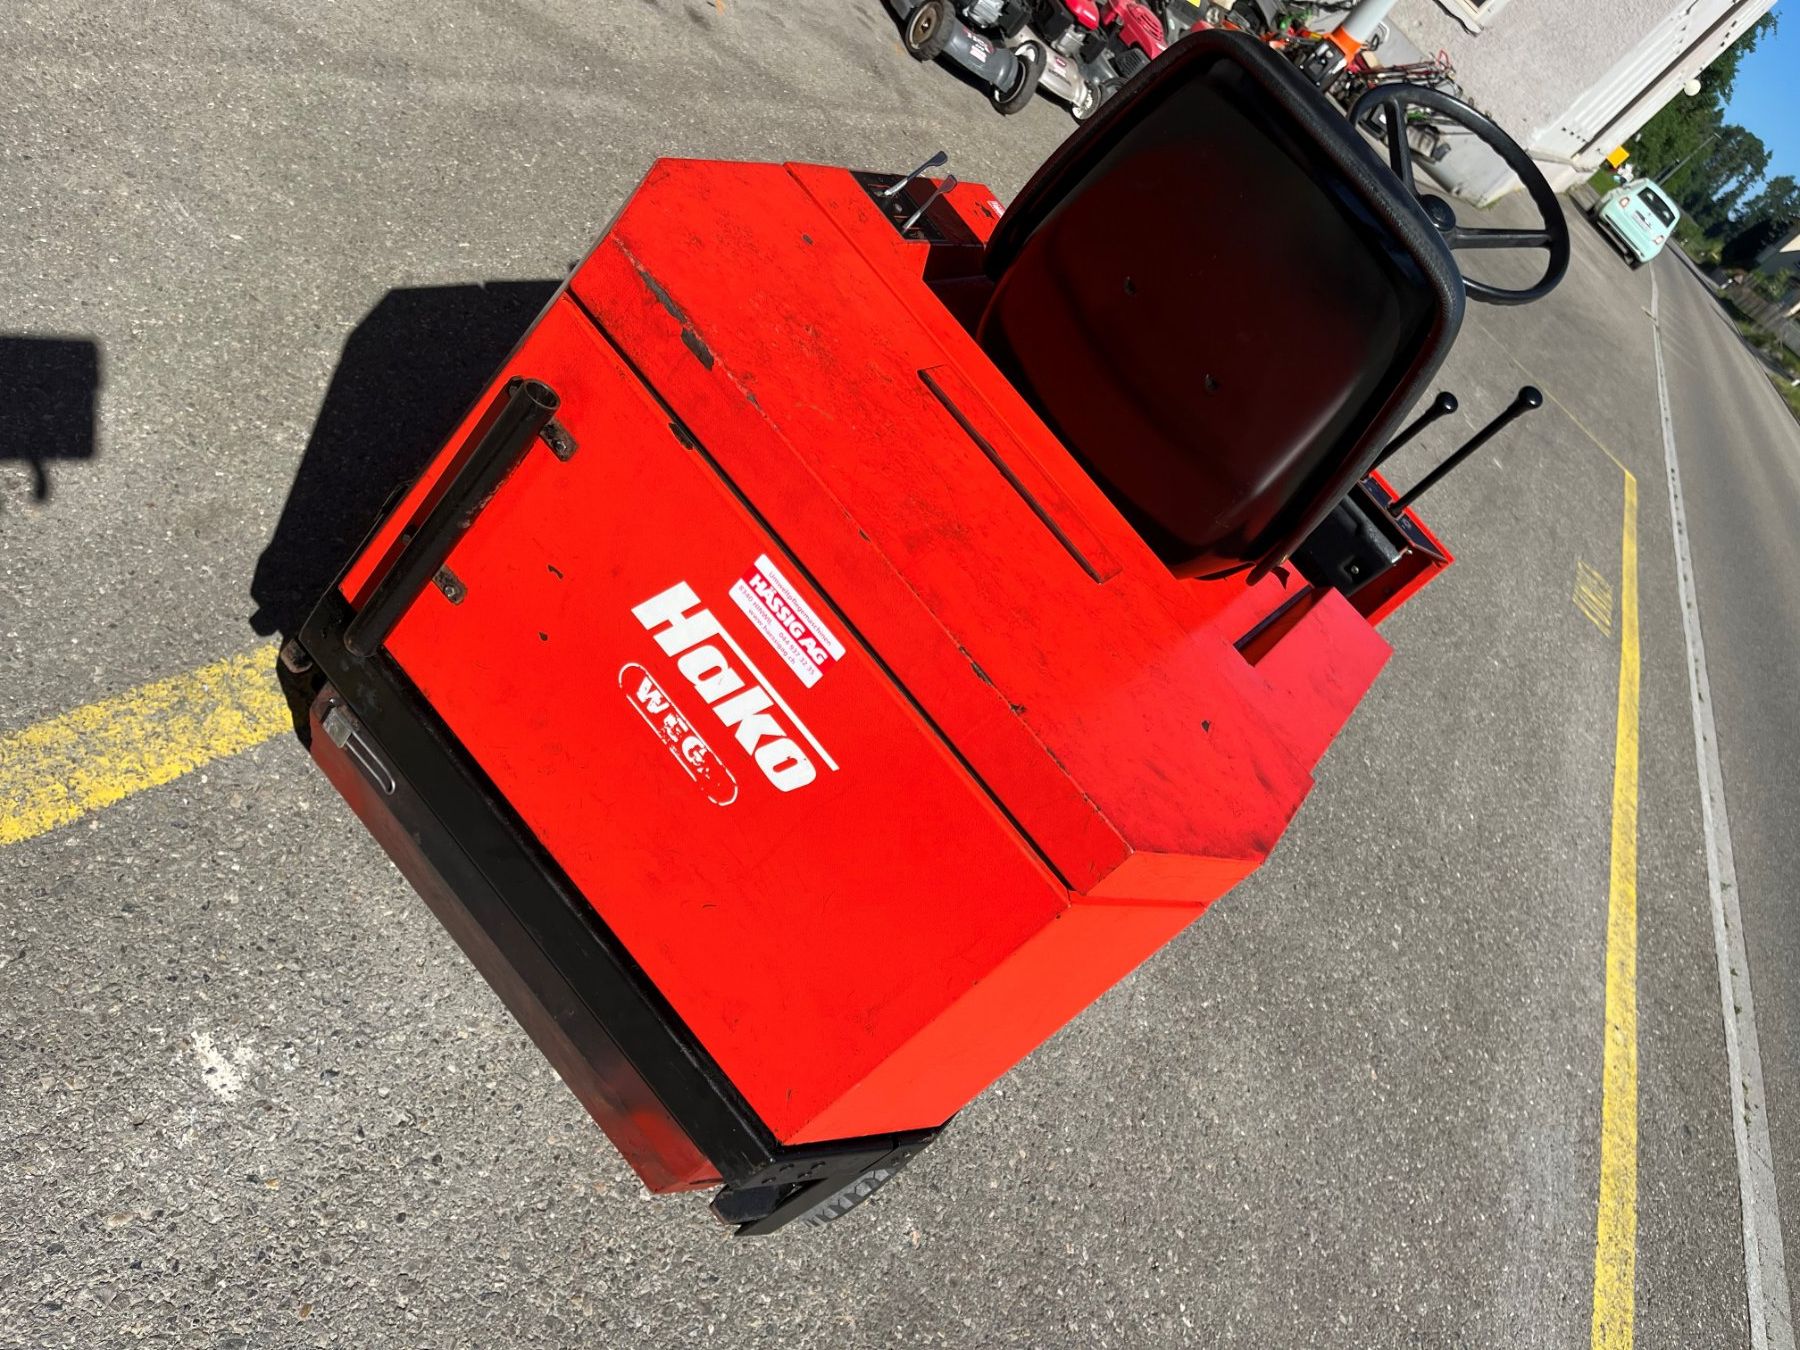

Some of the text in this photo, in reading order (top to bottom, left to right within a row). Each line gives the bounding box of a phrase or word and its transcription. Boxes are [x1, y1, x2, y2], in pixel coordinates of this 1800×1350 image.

[749, 572, 829, 665] HÄSSIG AG
[768, 571, 832, 647] Umweltpflegemaschinen
[631, 580, 817, 792] Hako
